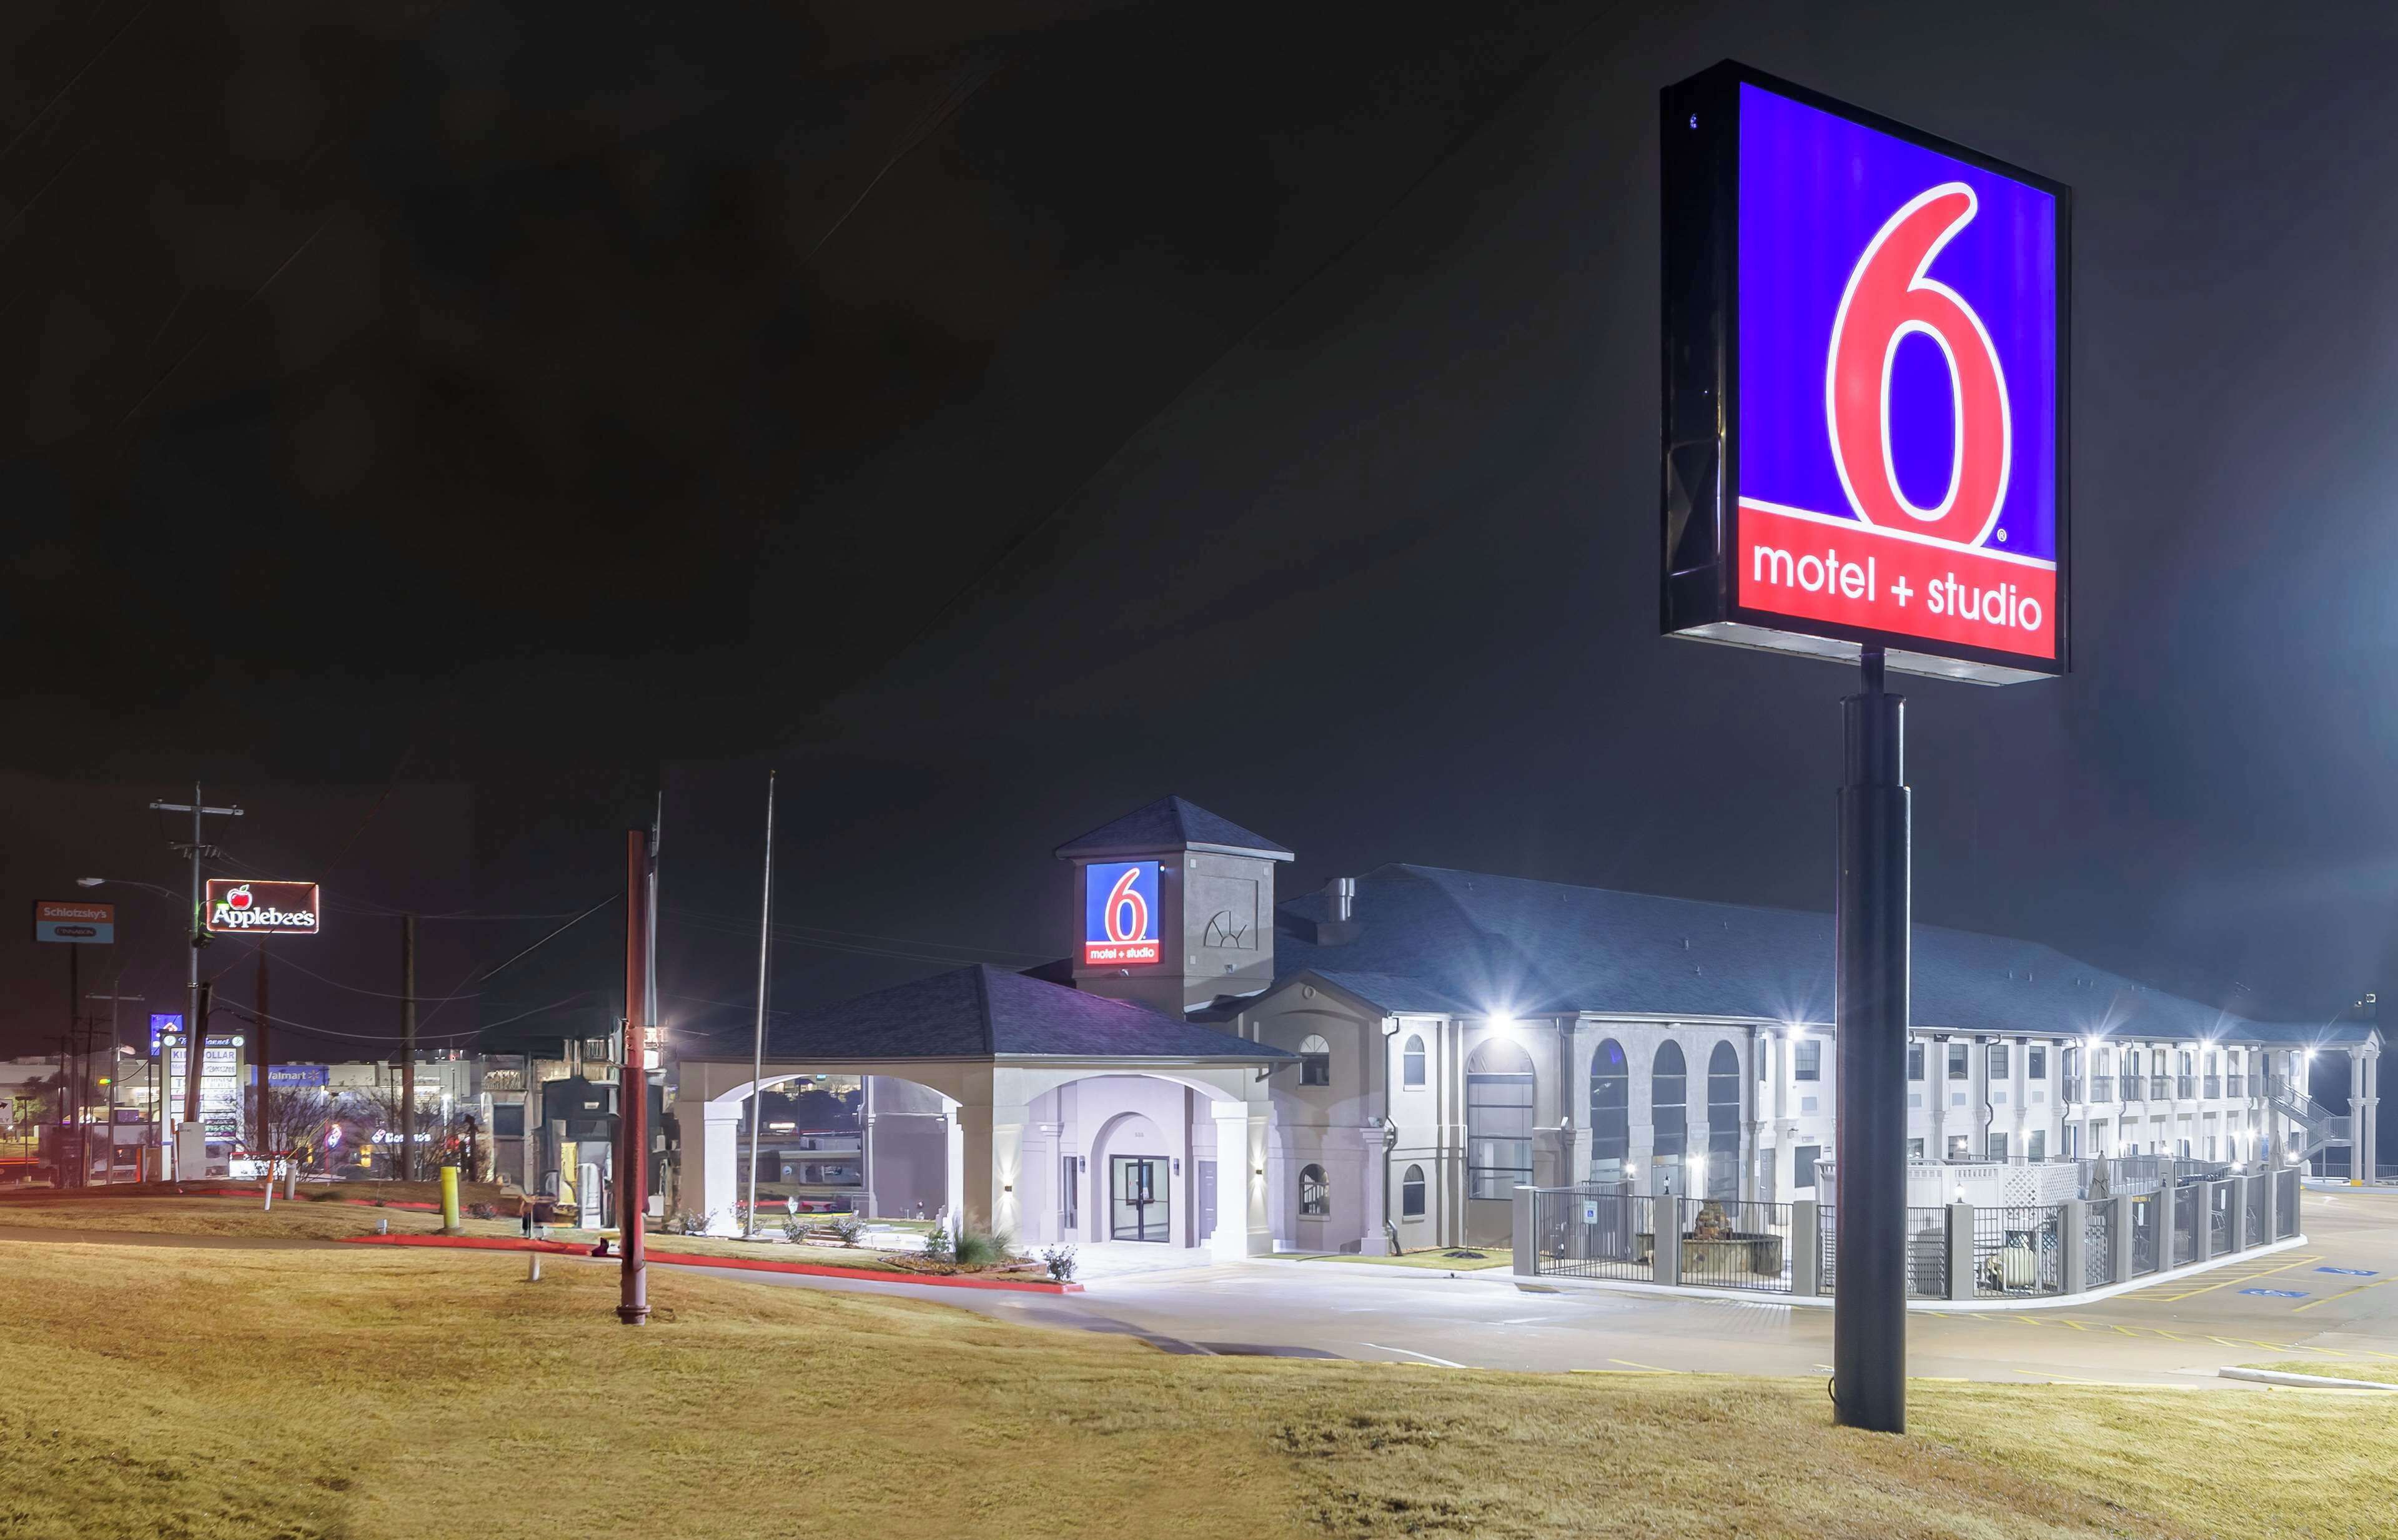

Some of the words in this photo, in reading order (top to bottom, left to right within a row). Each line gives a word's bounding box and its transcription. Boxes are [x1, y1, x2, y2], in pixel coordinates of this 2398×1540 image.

[1826, 182, 2012, 548] 6
[1754, 545, 1875, 601] motel
[1891, 575, 1914, 607] +
[1927, 572, 2043, 631] studio
[44, 907, 107, 920] Schlotzsky's
[1105, 867, 1148, 942] 6
[211, 907, 315, 928] Applebee's
[1090, 948, 1117, 959] motel
[1126, 947, 1155, 959] studio
[206, 1051, 235, 1059] OLLAR
